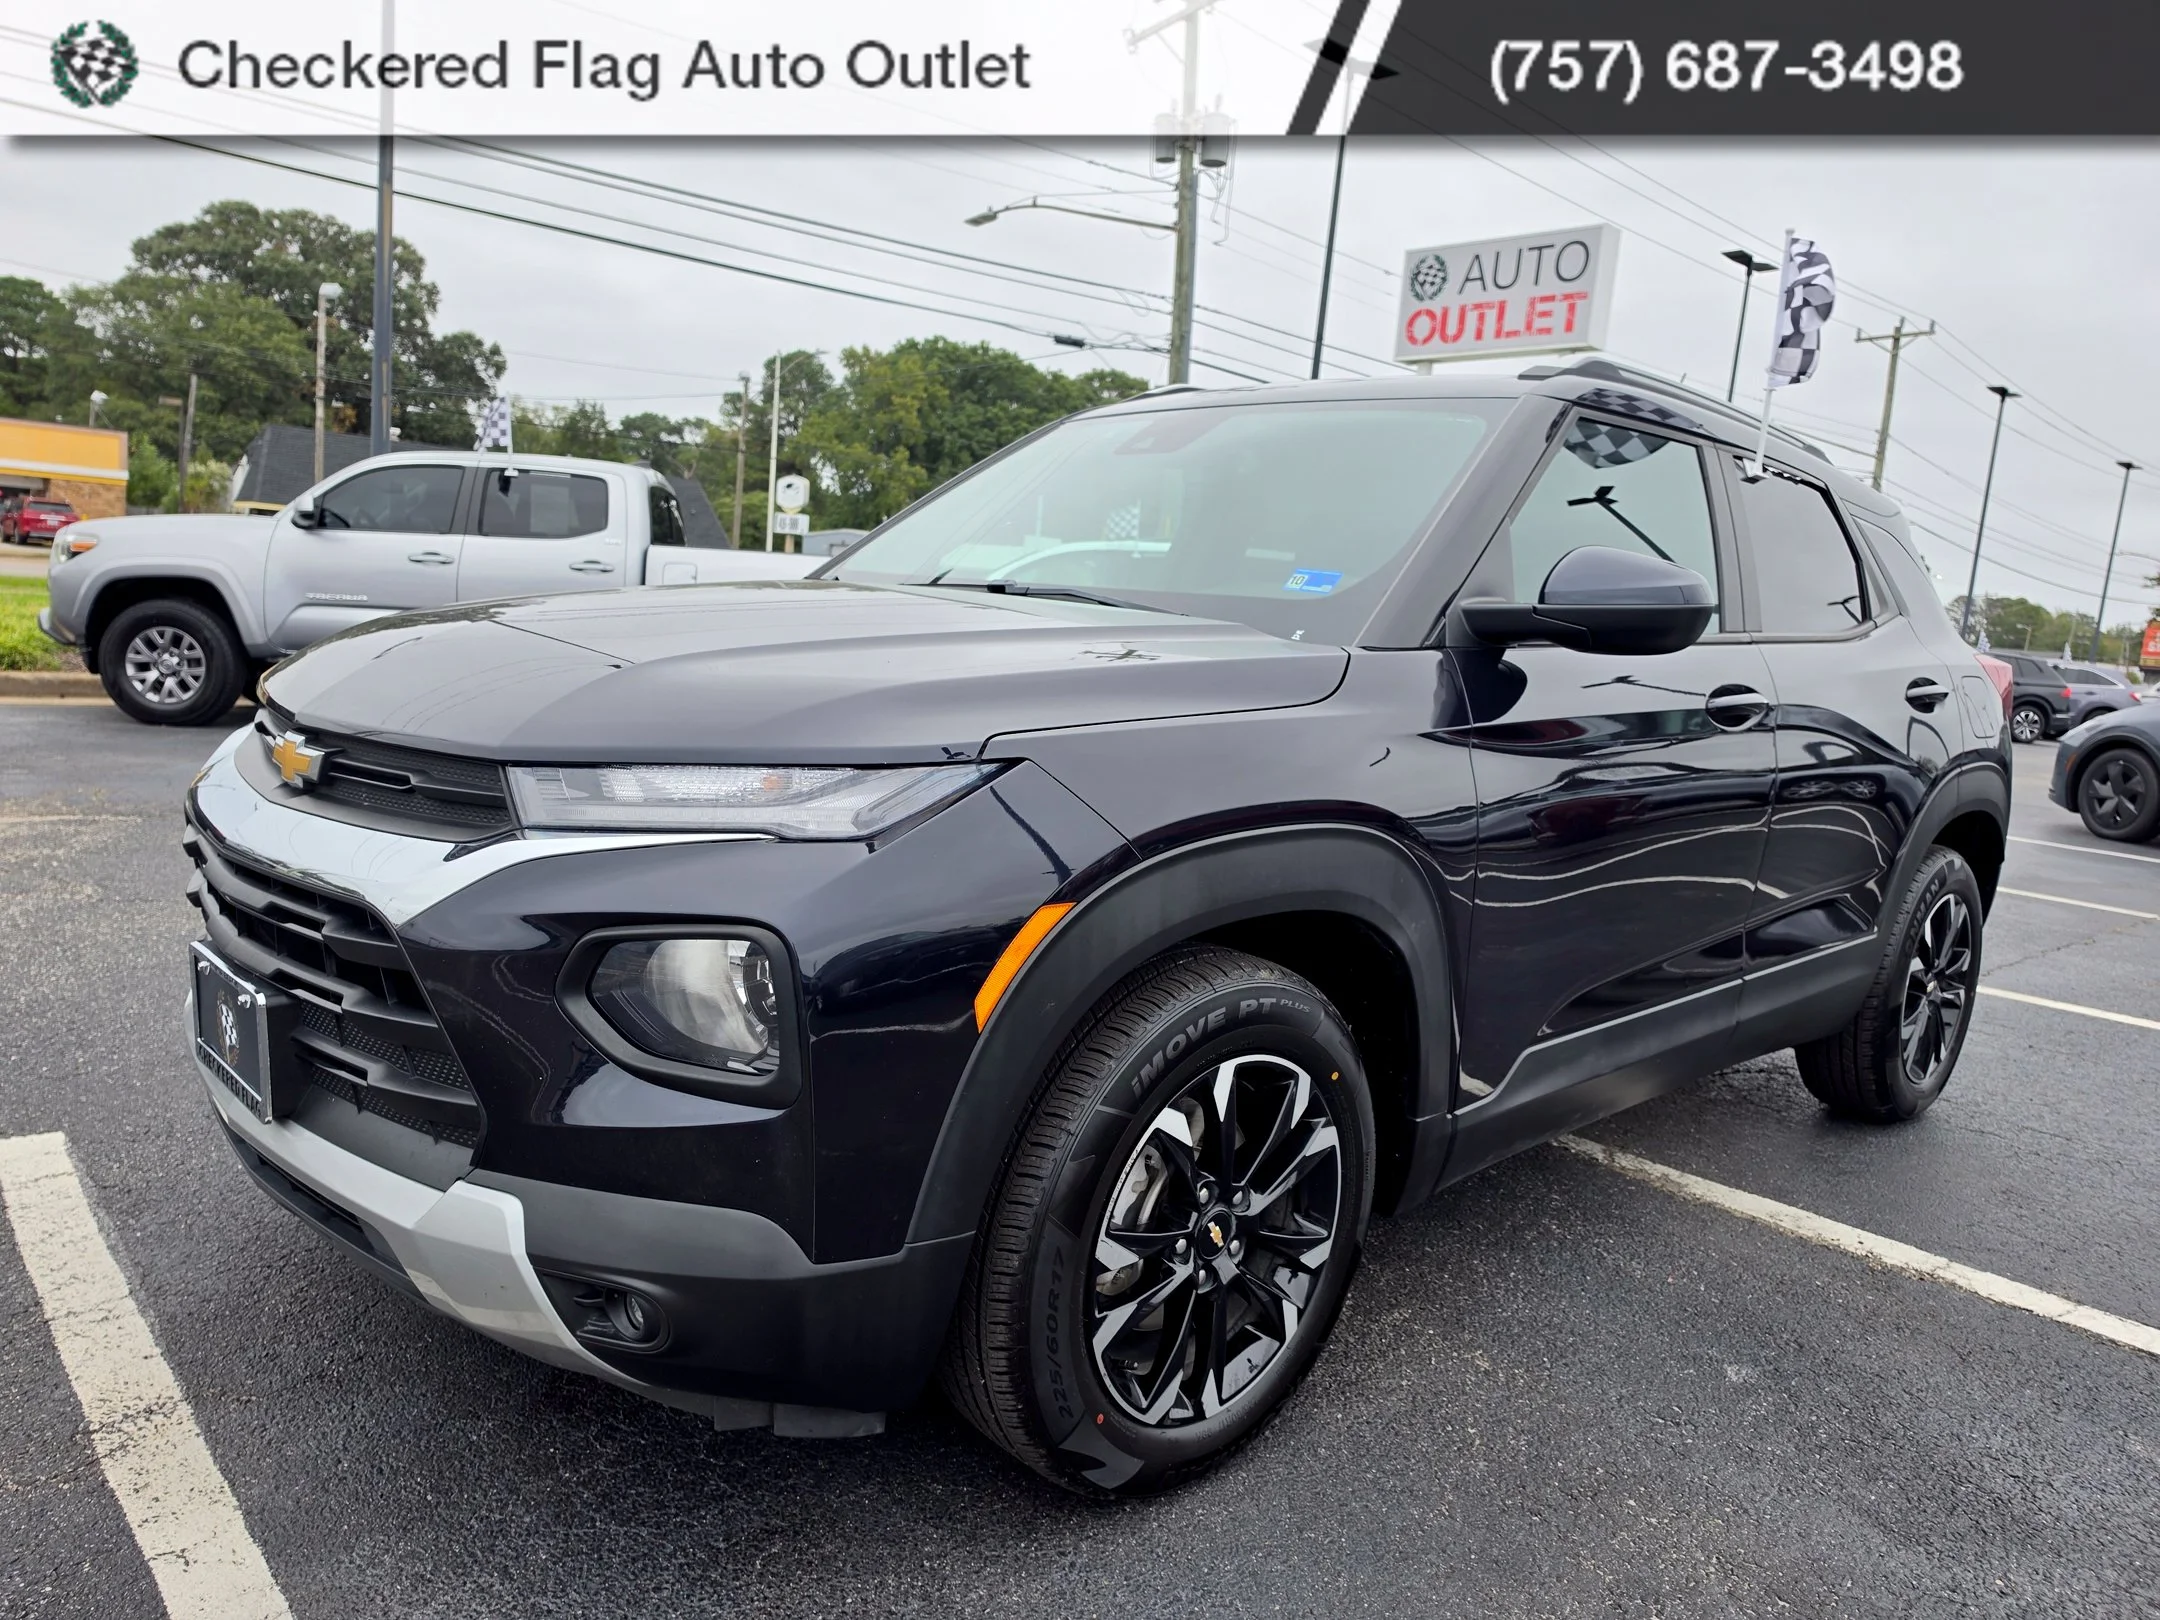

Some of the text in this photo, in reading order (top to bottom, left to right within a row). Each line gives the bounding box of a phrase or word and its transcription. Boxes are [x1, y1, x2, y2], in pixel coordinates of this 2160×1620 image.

[1458, 240, 1589, 296] AUTO
[1405, 291, 1588, 346] OUTLET
[1238, 997, 1277, 1019] PT
[1279, 998, 1312, 1013] PLUS
[1046, 1246, 1075, 1419] 225/60R17
